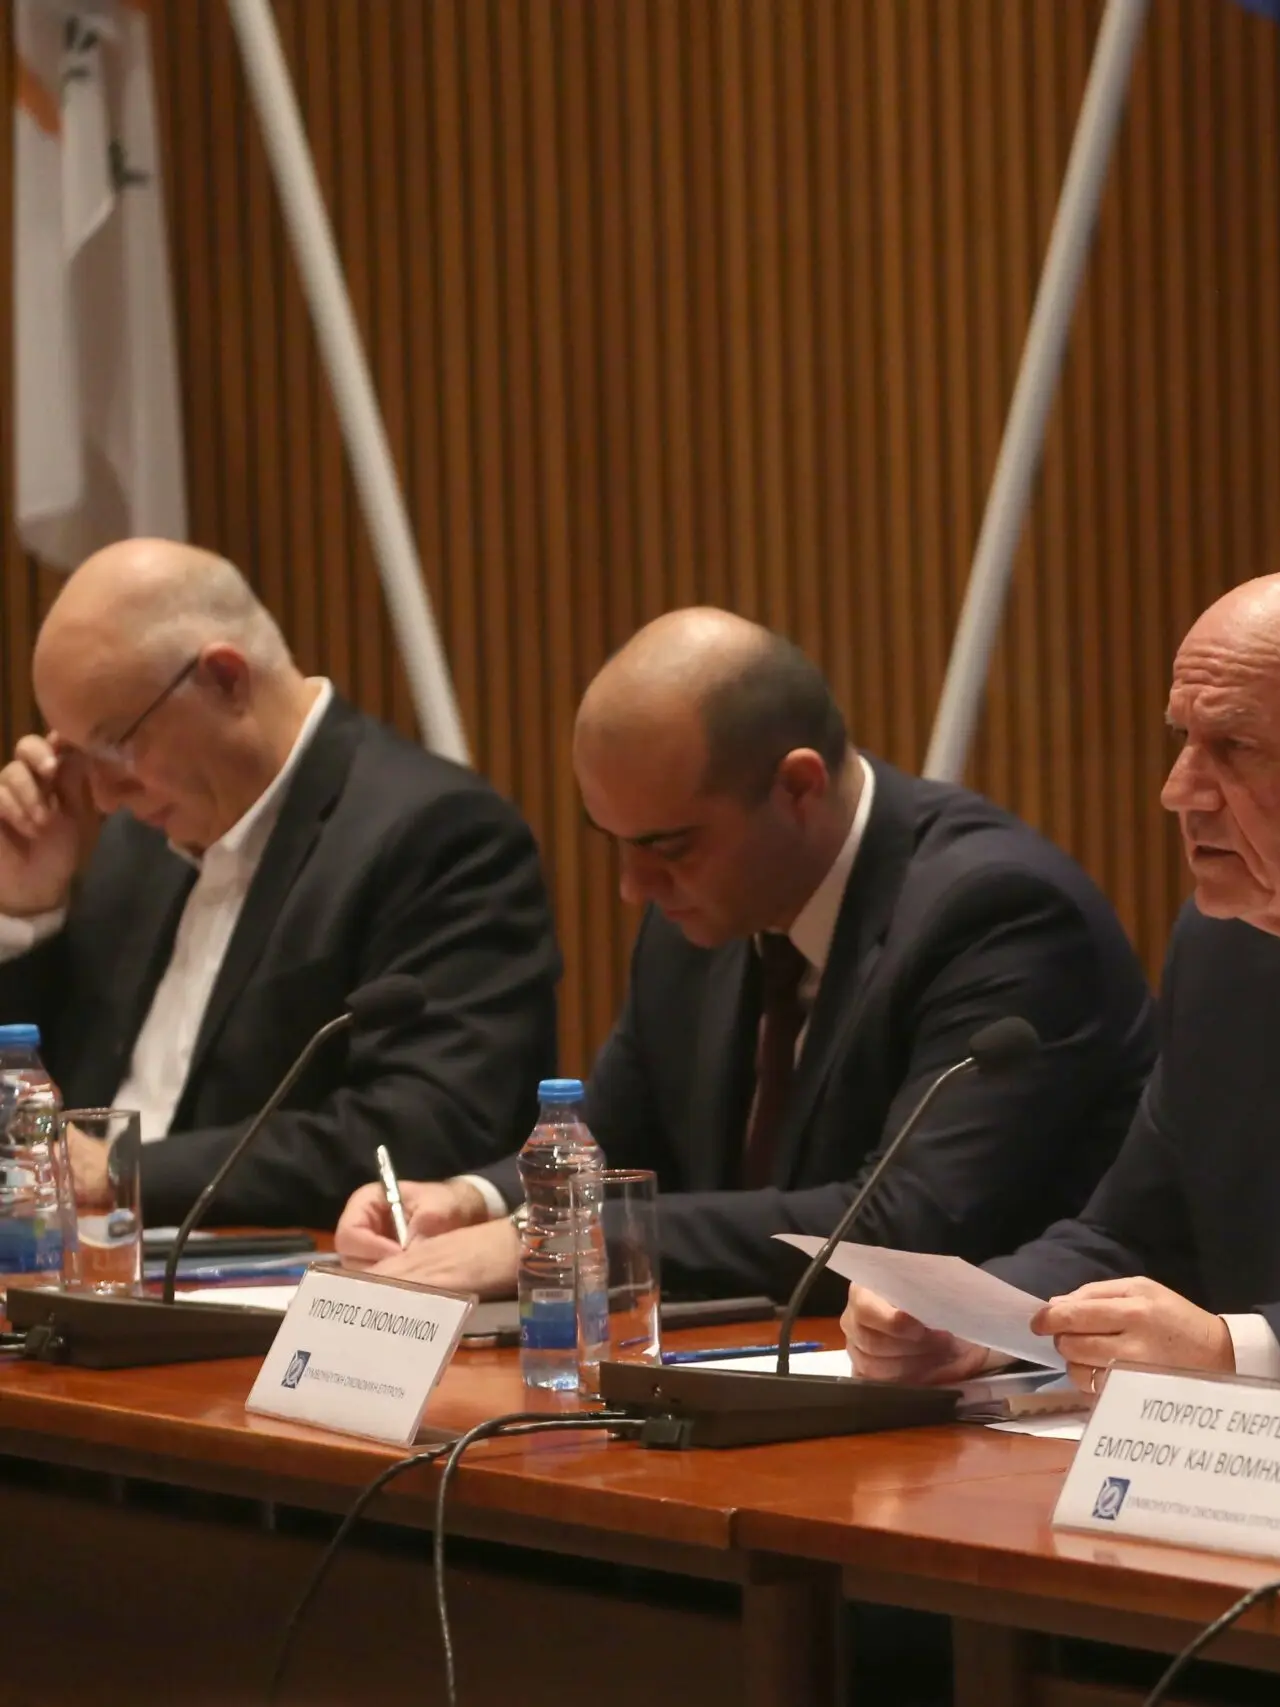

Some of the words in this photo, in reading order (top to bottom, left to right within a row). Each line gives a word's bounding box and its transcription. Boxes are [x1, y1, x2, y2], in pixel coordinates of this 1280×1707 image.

[309, 1298, 361, 1325] ΥΠΟΥΡΓΟΣ
[360, 1309, 439, 1342] ΟΙΚΟΝΟΜΙΚΩΝ
[1141, 1399, 1223, 1430] ΥΠΟΥΡΓΟΣ
[1094, 1436, 1180, 1466] ΕΜΠΟΡΙΟΥ
[1184, 1449, 1213, 1470] ΚΑΙ
